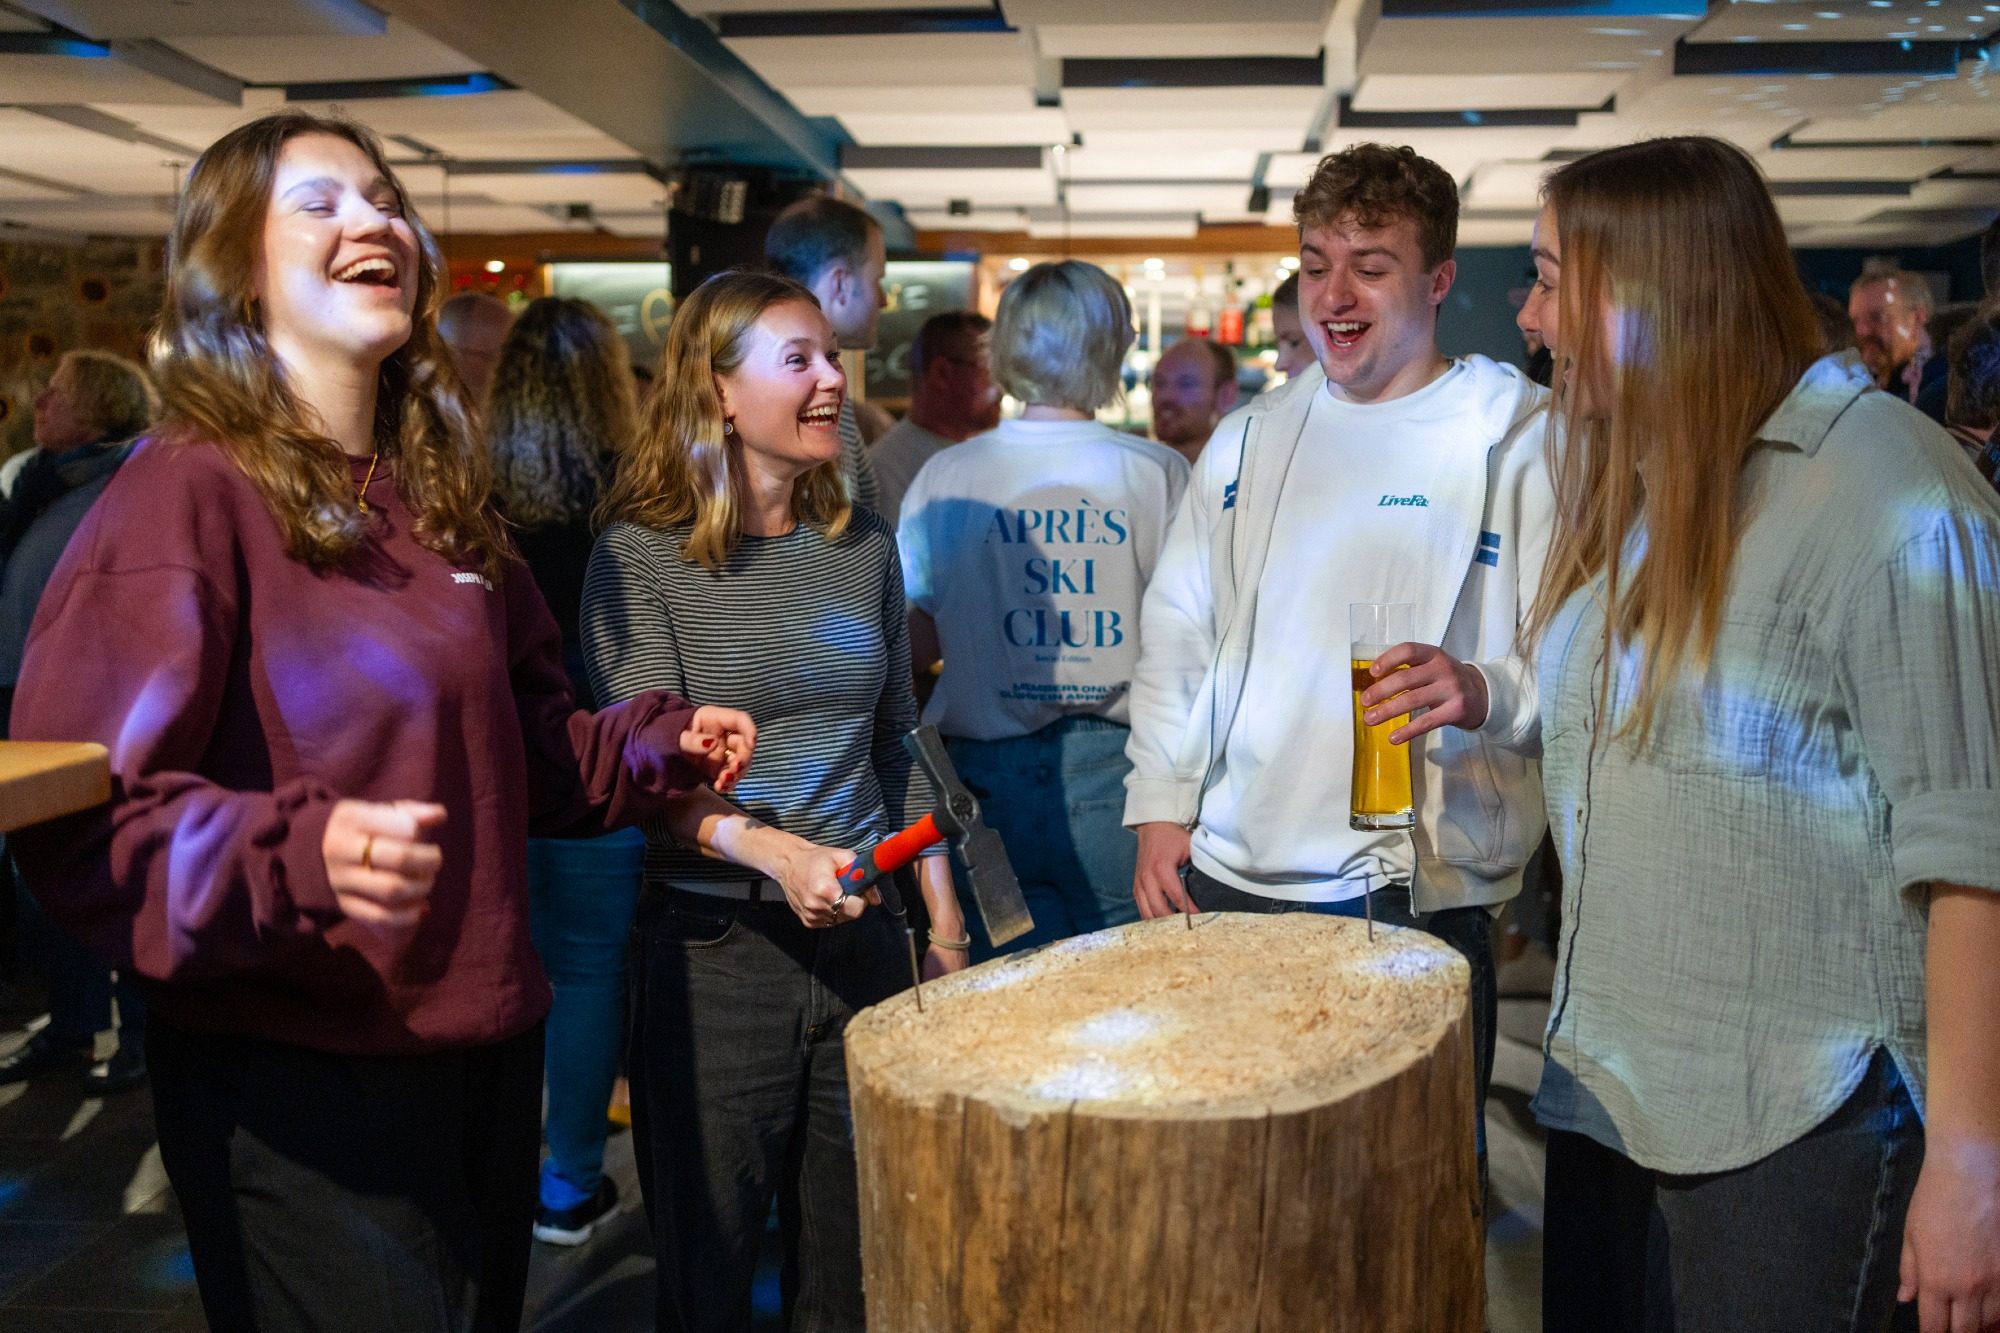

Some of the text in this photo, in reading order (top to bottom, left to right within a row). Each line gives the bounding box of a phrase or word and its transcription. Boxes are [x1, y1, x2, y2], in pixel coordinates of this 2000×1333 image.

[985, 499, 1126, 545] APRÈS
[1024, 558, 1095, 595] SKI
[1004, 608, 1123, 648] CLUB
[1013, 683, 1078, 692] MEMBERS
